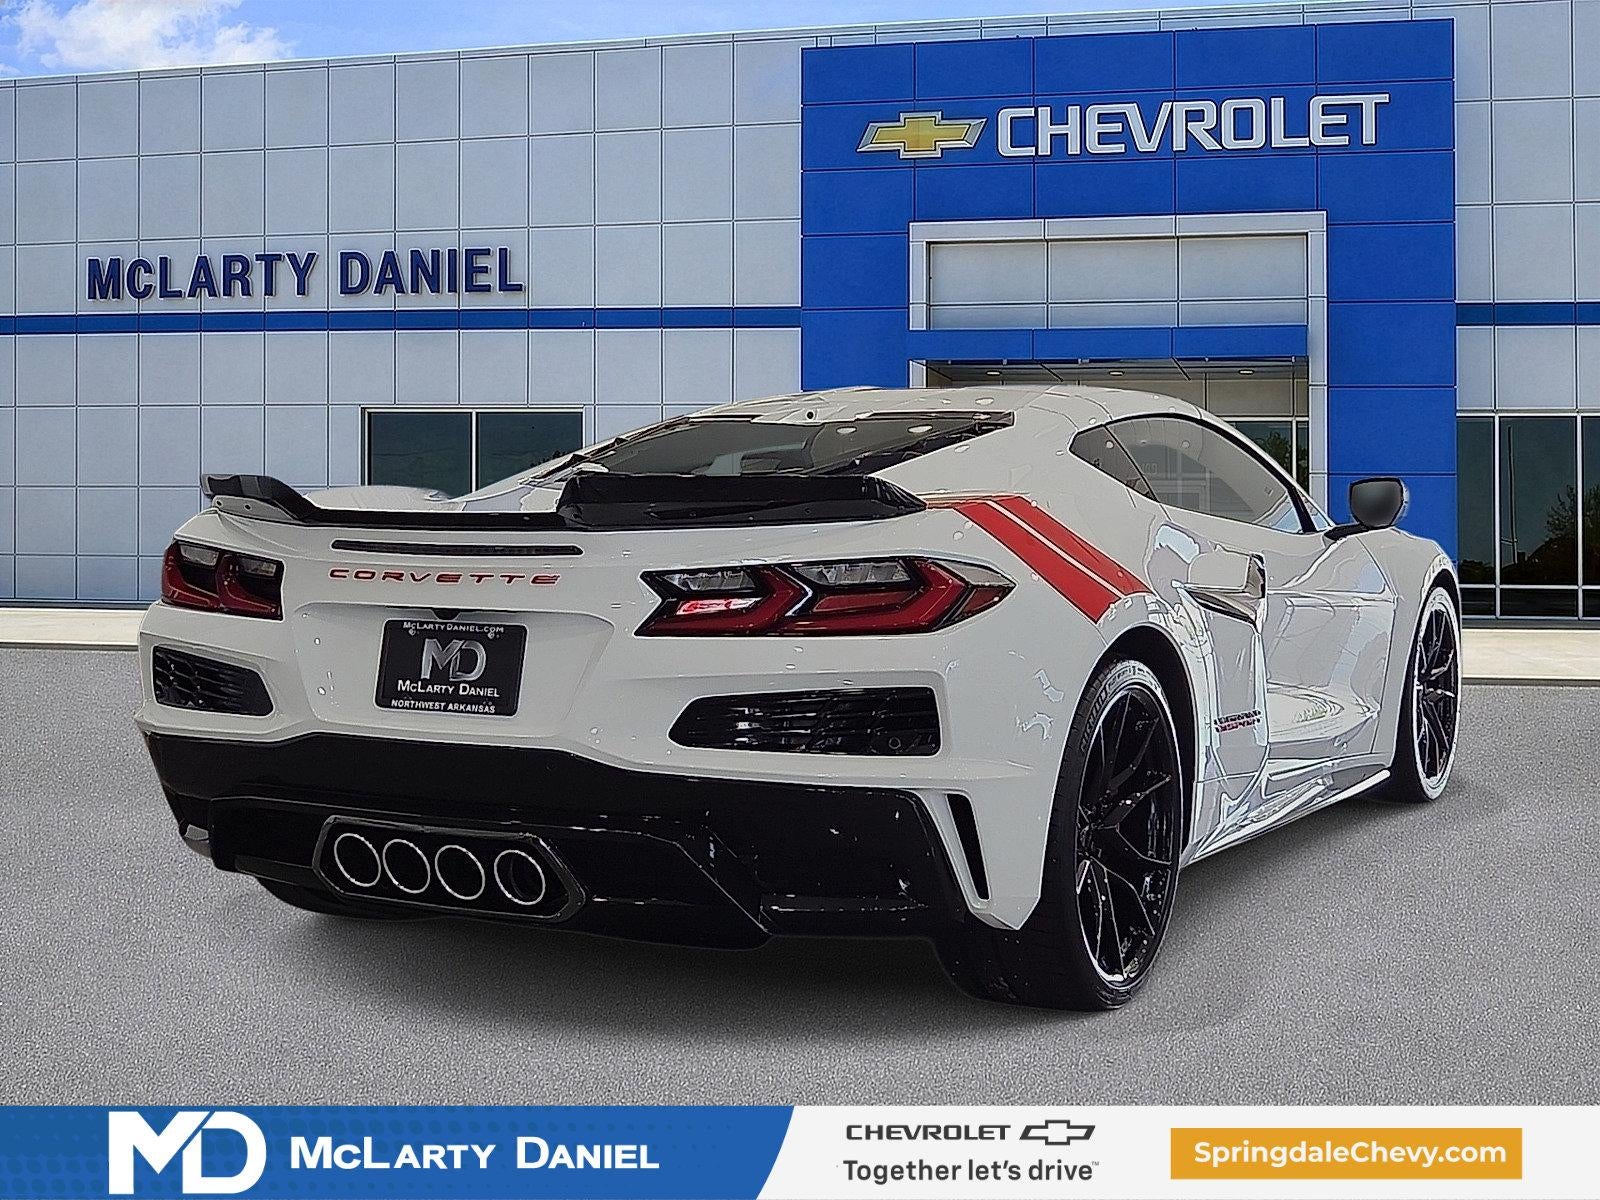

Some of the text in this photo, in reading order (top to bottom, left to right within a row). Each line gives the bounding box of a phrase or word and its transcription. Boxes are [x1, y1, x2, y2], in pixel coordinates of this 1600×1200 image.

[996, 93, 1390, 157] CHEVROLET
[338, 246, 524, 296] DANIEL
[328, 568, 561, 586] CORVETTE
[421, 638, 487, 681] MD
[459, 682, 500, 698] DANIEL
[391, 699, 496, 714] NORTHWEST ARKANSAS
